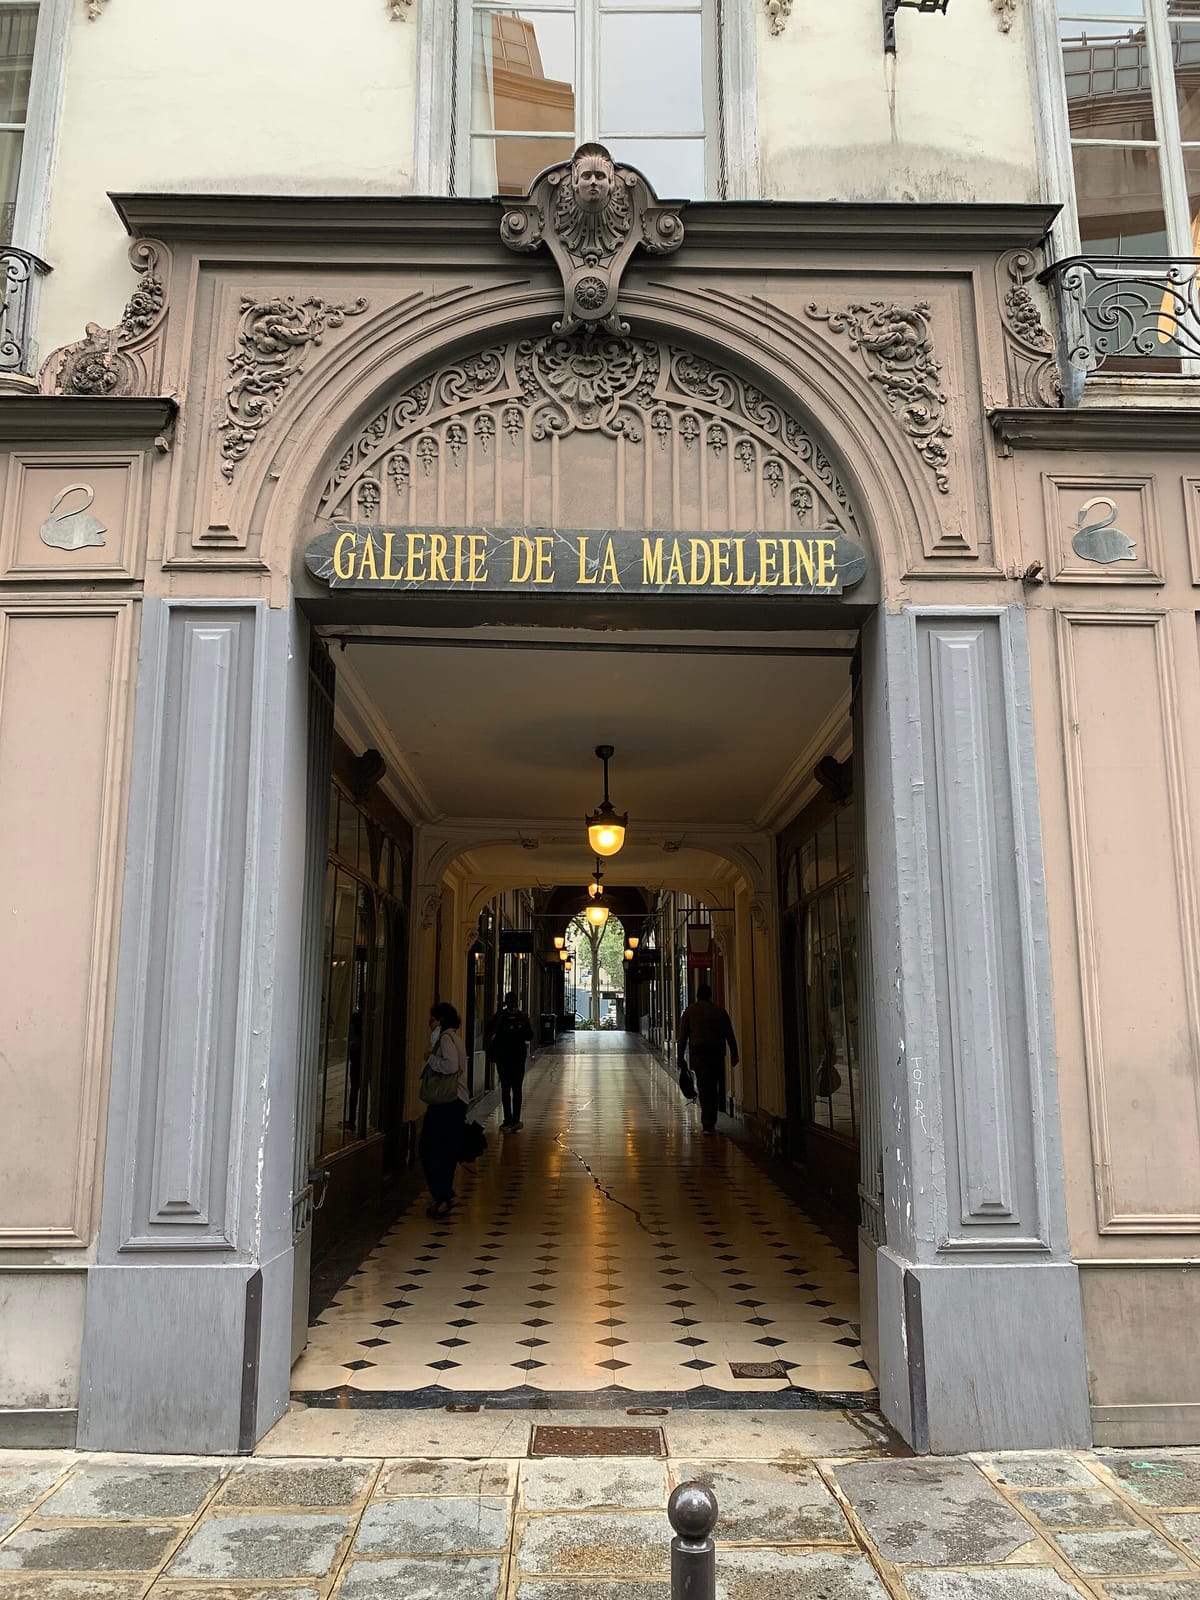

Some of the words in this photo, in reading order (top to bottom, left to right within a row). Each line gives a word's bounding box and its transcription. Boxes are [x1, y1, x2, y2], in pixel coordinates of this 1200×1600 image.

[332, 531, 488, 583] GALERIE
[510, 536, 554, 584] DE
[576, 537, 621, 585] LA
[642, 539, 839, 587] MADELEINE
